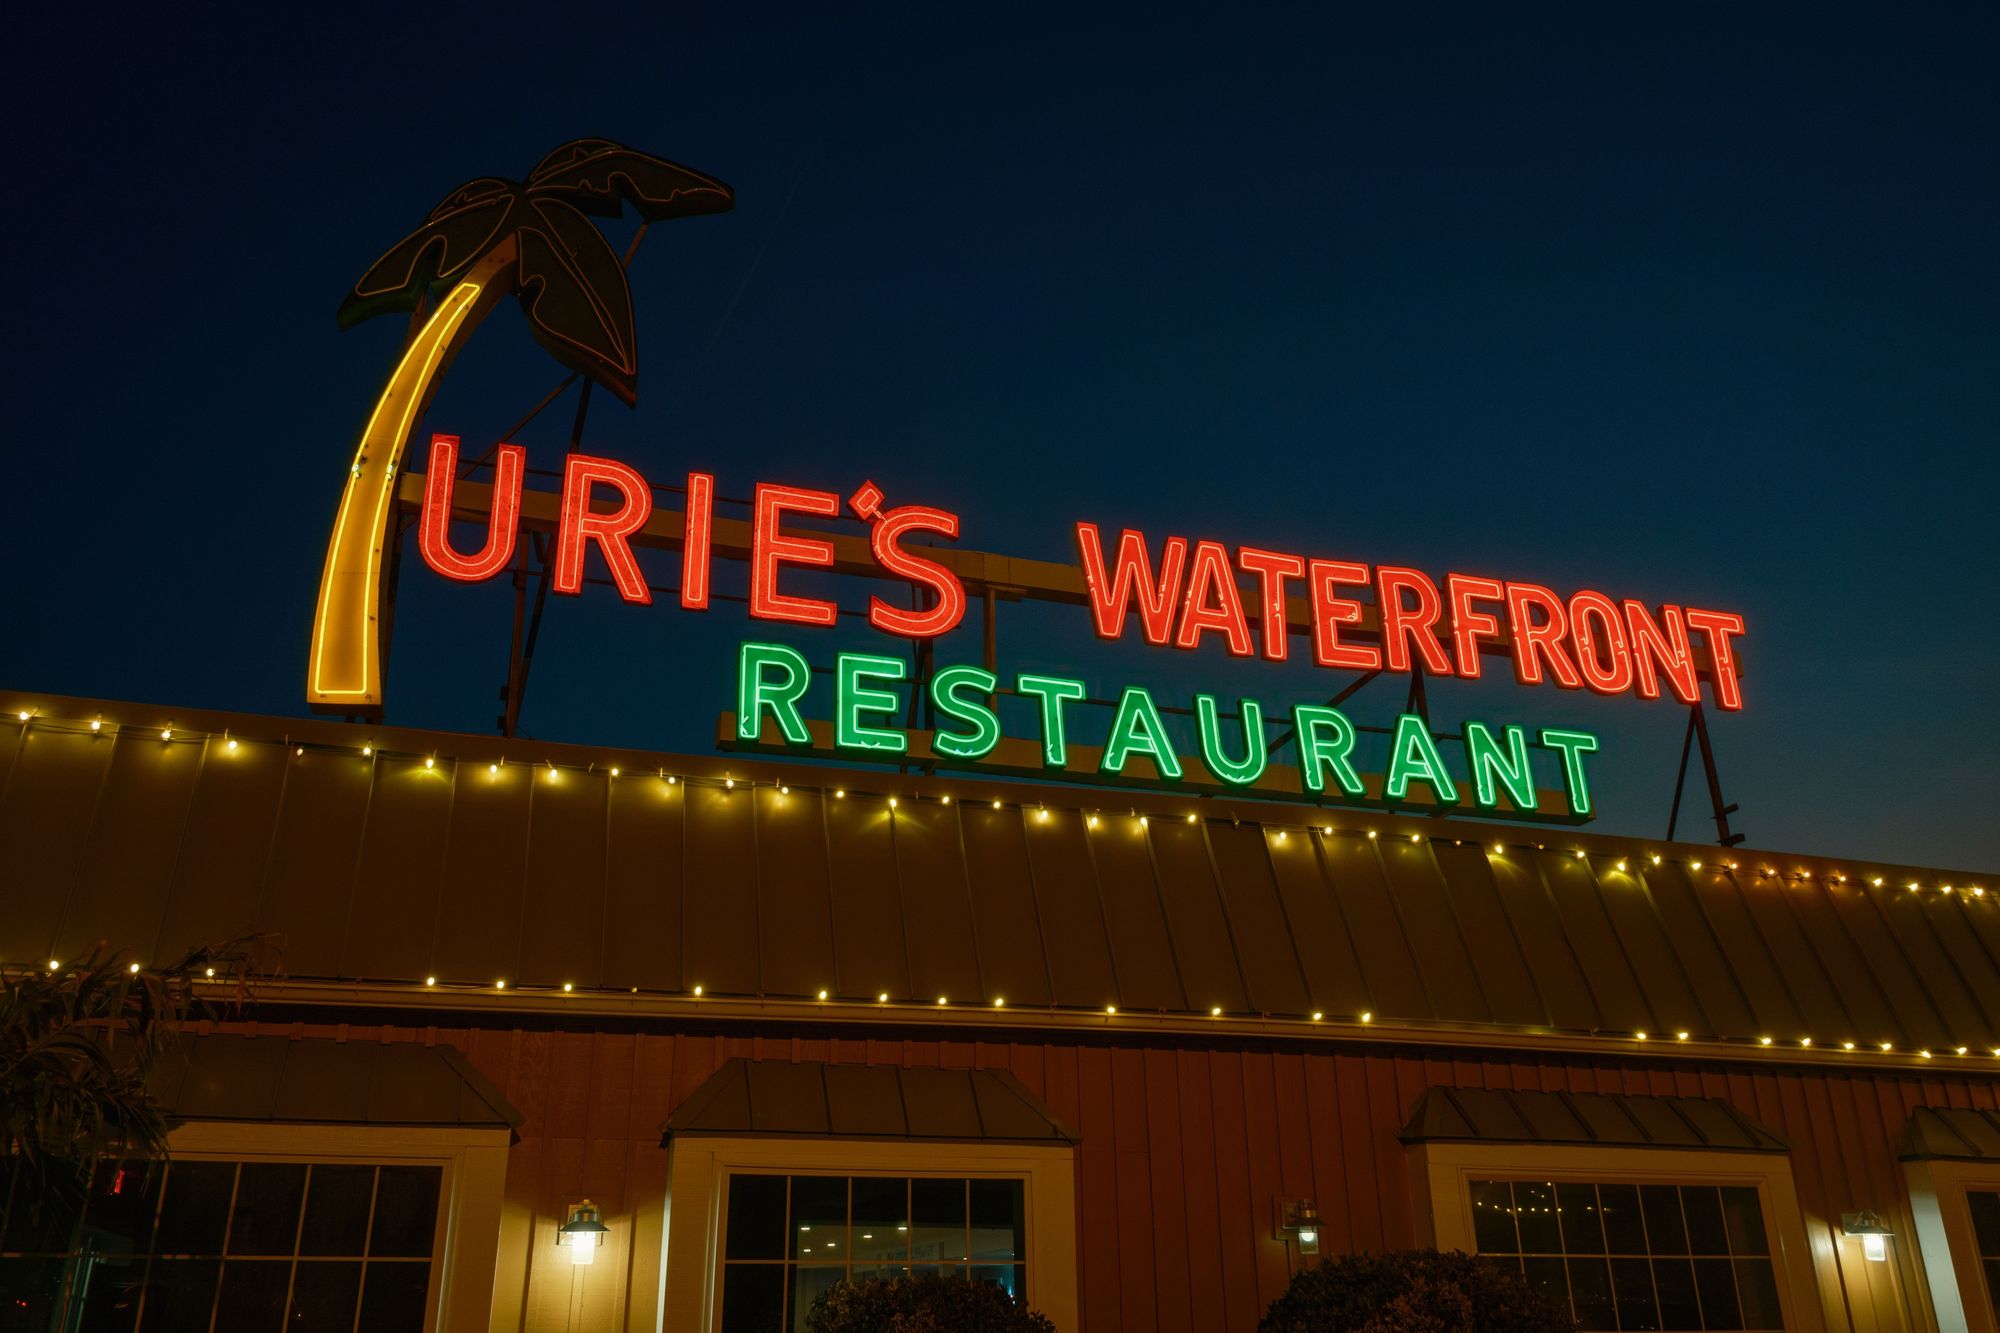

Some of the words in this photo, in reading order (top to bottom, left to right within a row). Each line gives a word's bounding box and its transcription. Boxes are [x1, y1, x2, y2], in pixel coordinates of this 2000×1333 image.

[418, 434, 967, 638] URIE'S
[1076, 521, 1744, 711] WATERFRONT
[736, 641, 1599, 816] RESTAURANT
